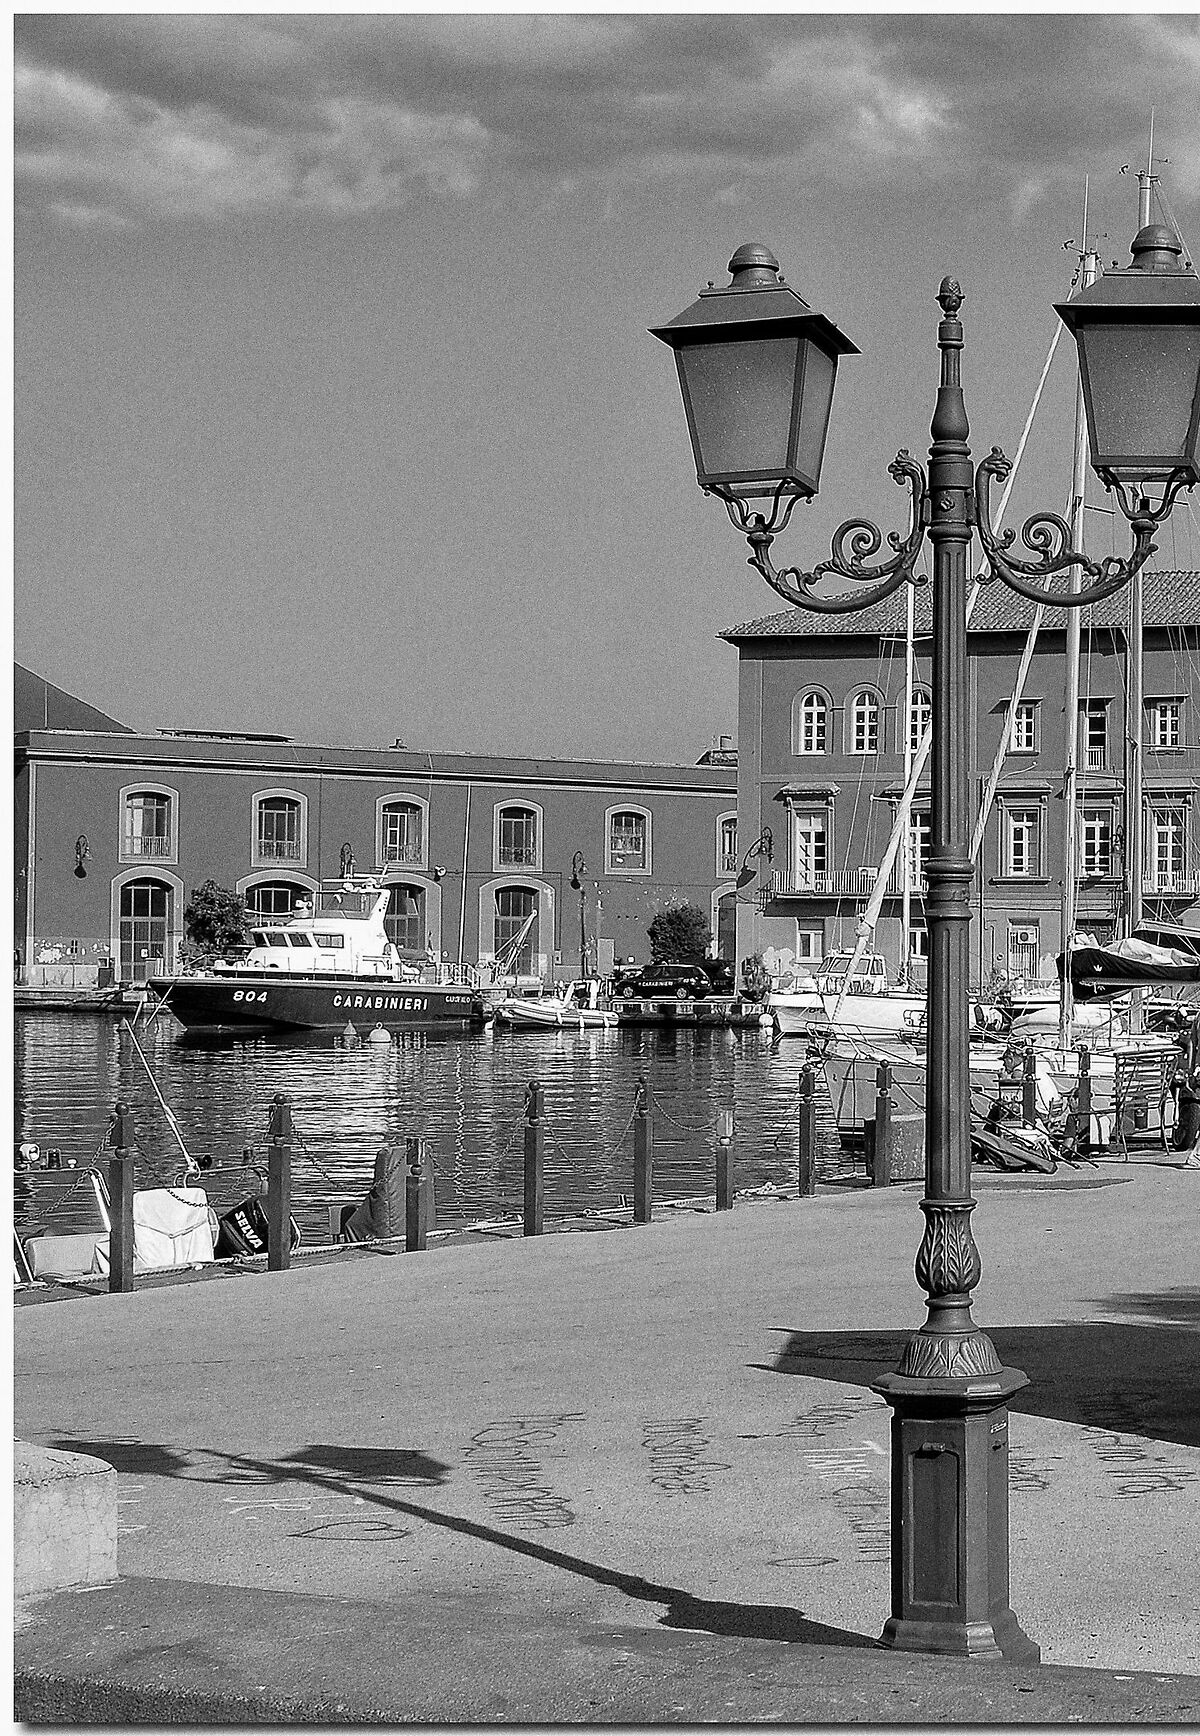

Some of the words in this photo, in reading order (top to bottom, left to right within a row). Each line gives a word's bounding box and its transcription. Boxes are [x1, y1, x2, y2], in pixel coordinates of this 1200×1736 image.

[233, 990, 268, 1003] 804
[333, 994, 428, 1011] CARABINIERI
[234, 1210, 264, 1249] SELVA
